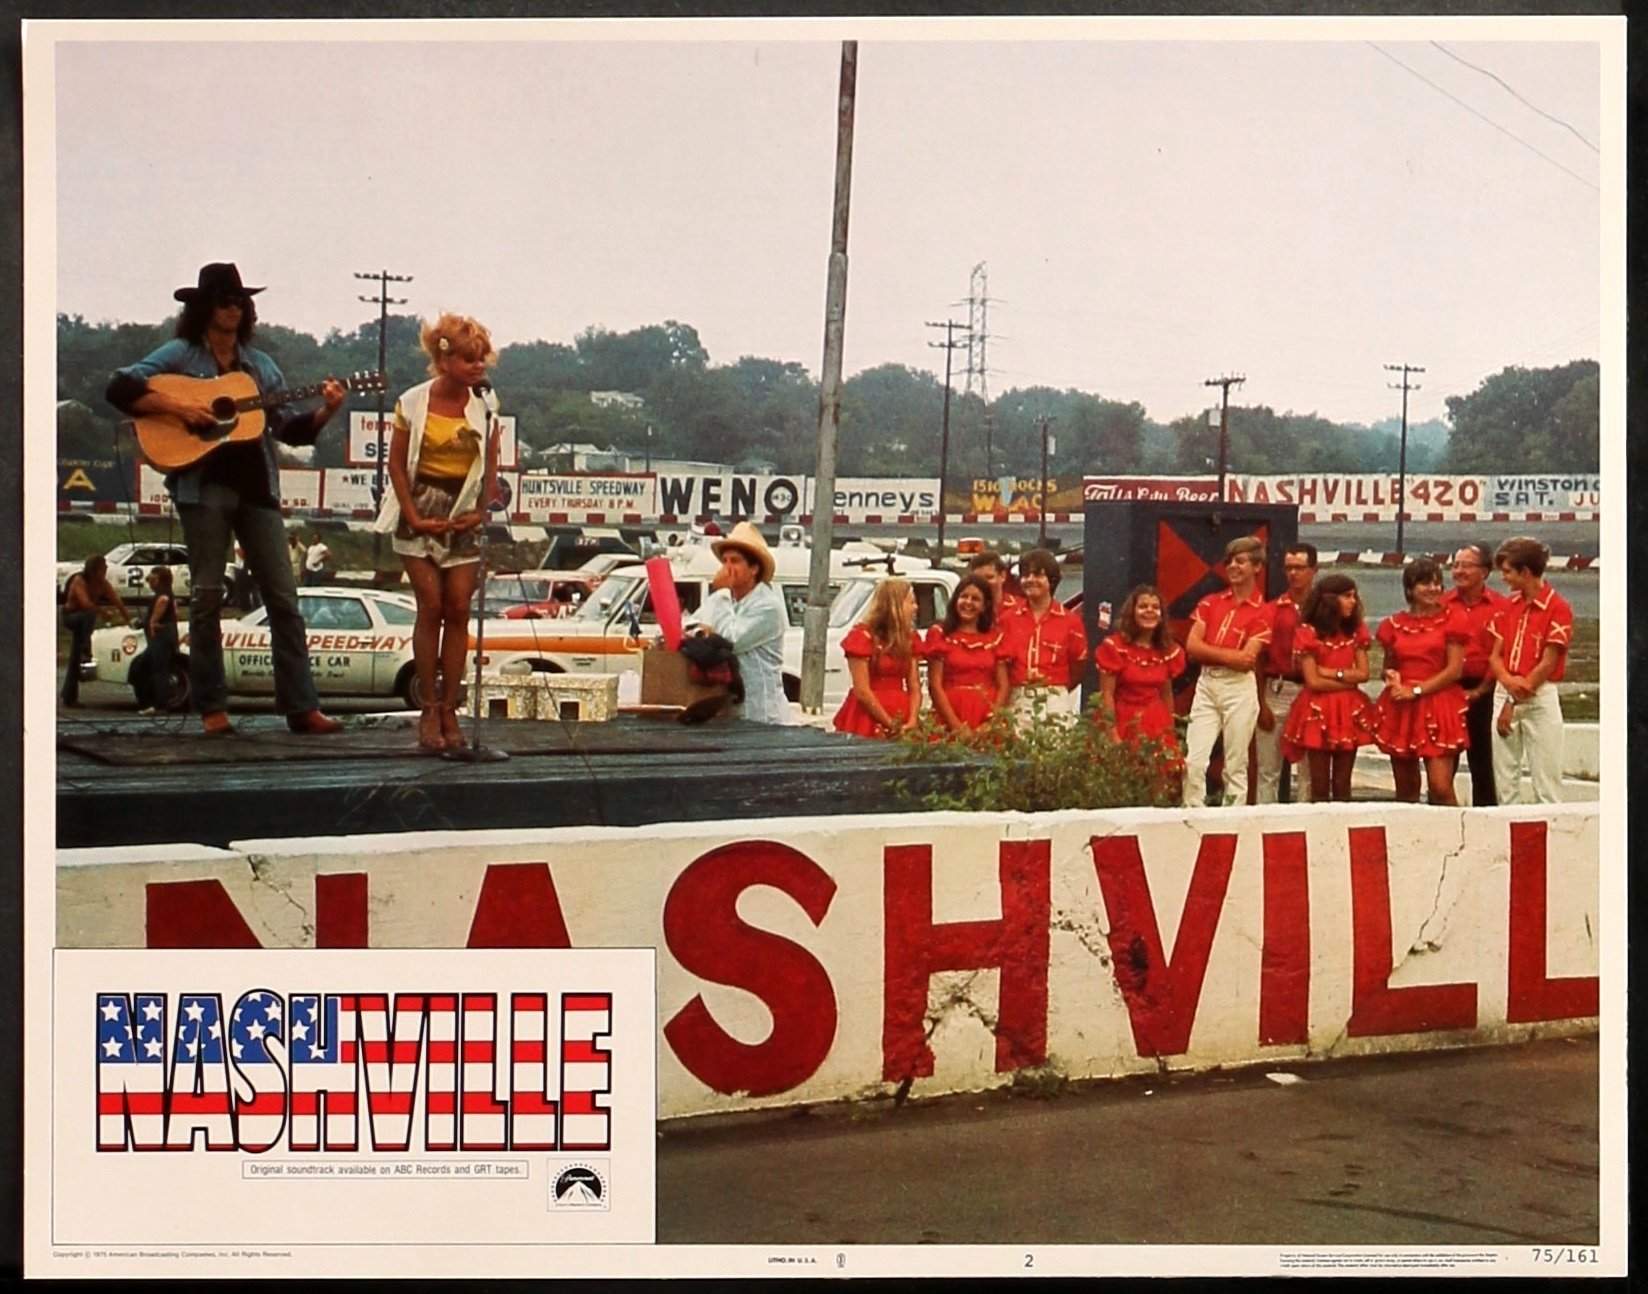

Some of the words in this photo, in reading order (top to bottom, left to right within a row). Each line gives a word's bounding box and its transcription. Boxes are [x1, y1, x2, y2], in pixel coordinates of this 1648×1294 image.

[522, 479, 582, 495] HUNTSVILLE
[590, 480, 646, 496] SPEEDWAY
[1228, 479, 1400, 506] NASHVILLE
[528, 498, 556, 509] EVERY
[562, 498, 603, 509] THURSDAY
[660, 477, 798, 516] WENO
[832, 490, 935, 512] enneys
[1495, 492, 1554, 506] SAT.
[127, 567, 144, 588] 2
[305, 634, 413, 650] PEEDWAY
[327, 656, 350, 668] CAR
[96, 988, 613, 1154] NASHVILLE
[250, 1164, 283, 1177] Original
[287, 1164, 334, 1175] soundtrack
[338, 1164, 376, 1175] available
[380, 1164, 391, 1175] on
[394, 1164, 413, 1175] ABC
[416, 1164, 451, 1175] Records
[454, 1164, 470, 1175] and
[474, 1164, 492, 1175] GRT
[1024, 1254, 1034, 1268] 2
[1531, 1248, 1599, 1263] 75/161
